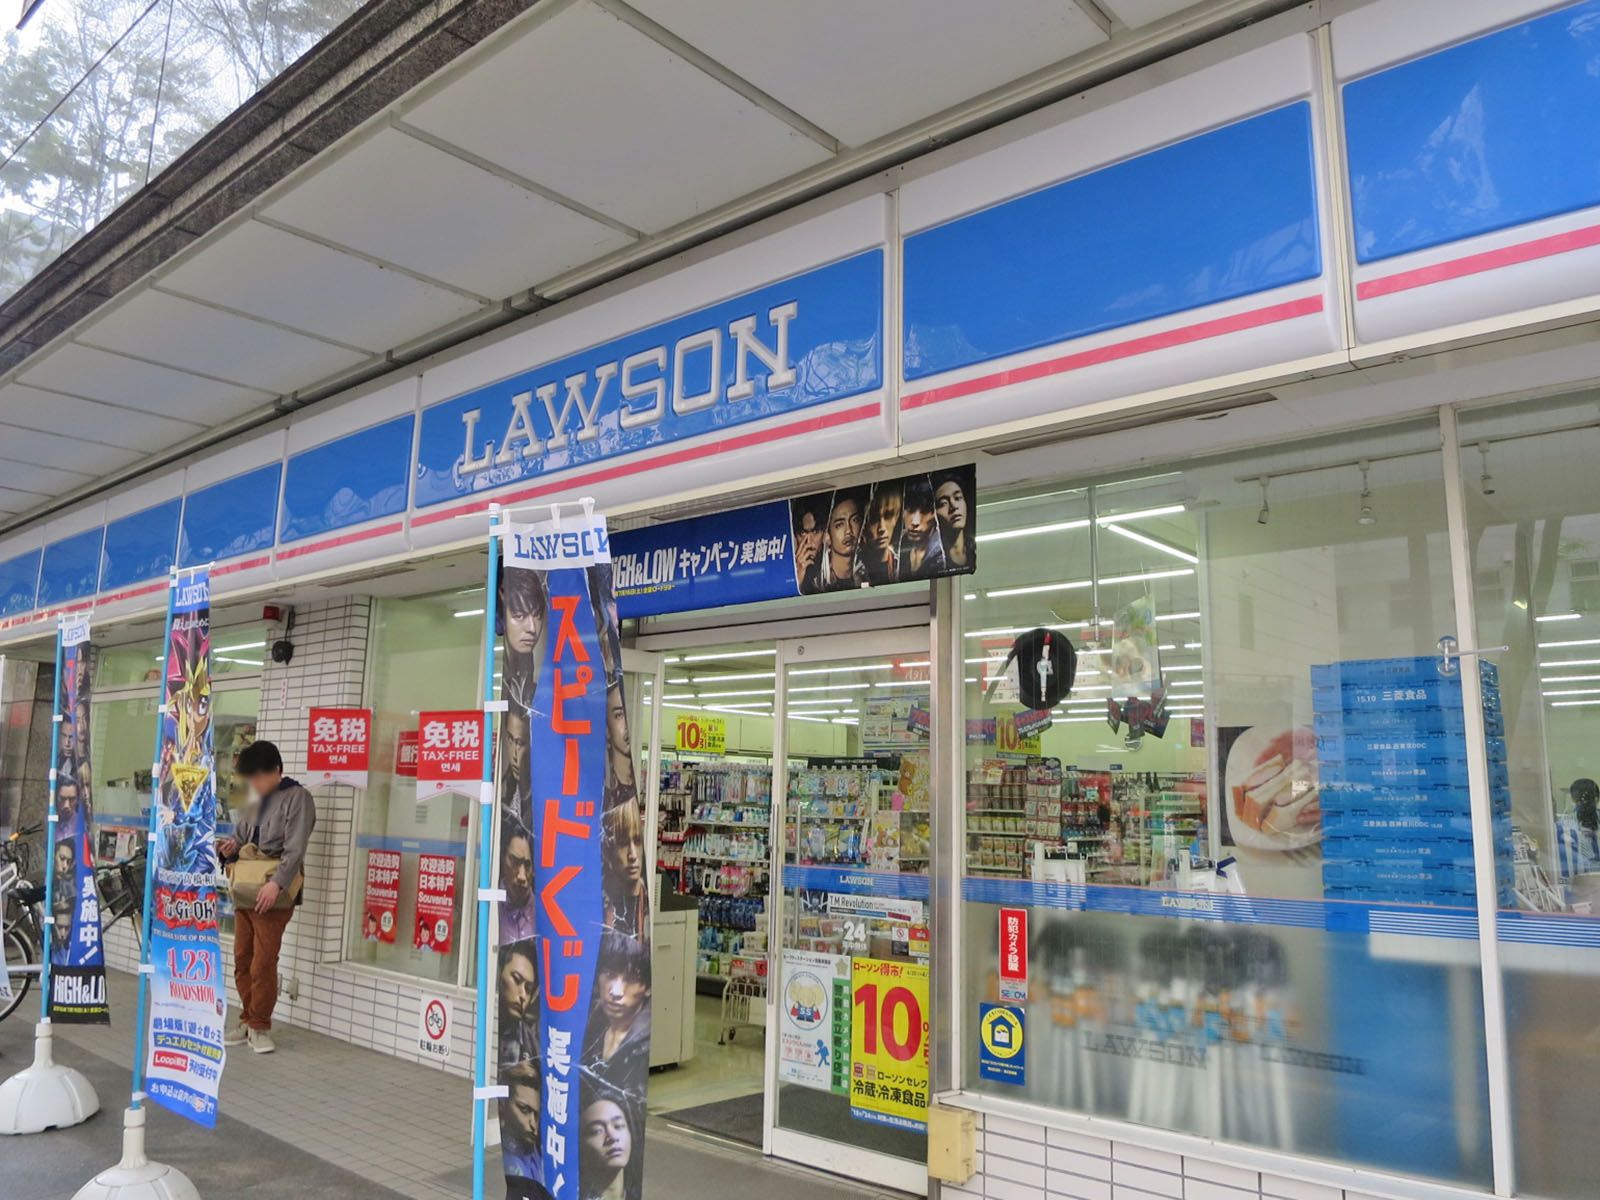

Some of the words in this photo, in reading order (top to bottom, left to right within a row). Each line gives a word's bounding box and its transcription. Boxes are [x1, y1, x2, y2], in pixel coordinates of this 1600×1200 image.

[458, 302, 797, 474] LAWSON
[679, 541, 739, 578] キャンペーン
[741, 534, 787, 565] 実施中!
[313, 717, 366, 742] 免税
[422, 720, 480, 748] 免税
[312, 743, 365, 754] TAX-FREE
[422, 750, 479, 761] TAX-FREE
[541, 596, 594, 1012] スピードくじ
[840, 875, 874, 886] LAWSON
[418, 891, 452, 906] Souvenirs
[843, 920, 866, 942] 24
[877, 1071, 928, 1088] ローソンセレク
